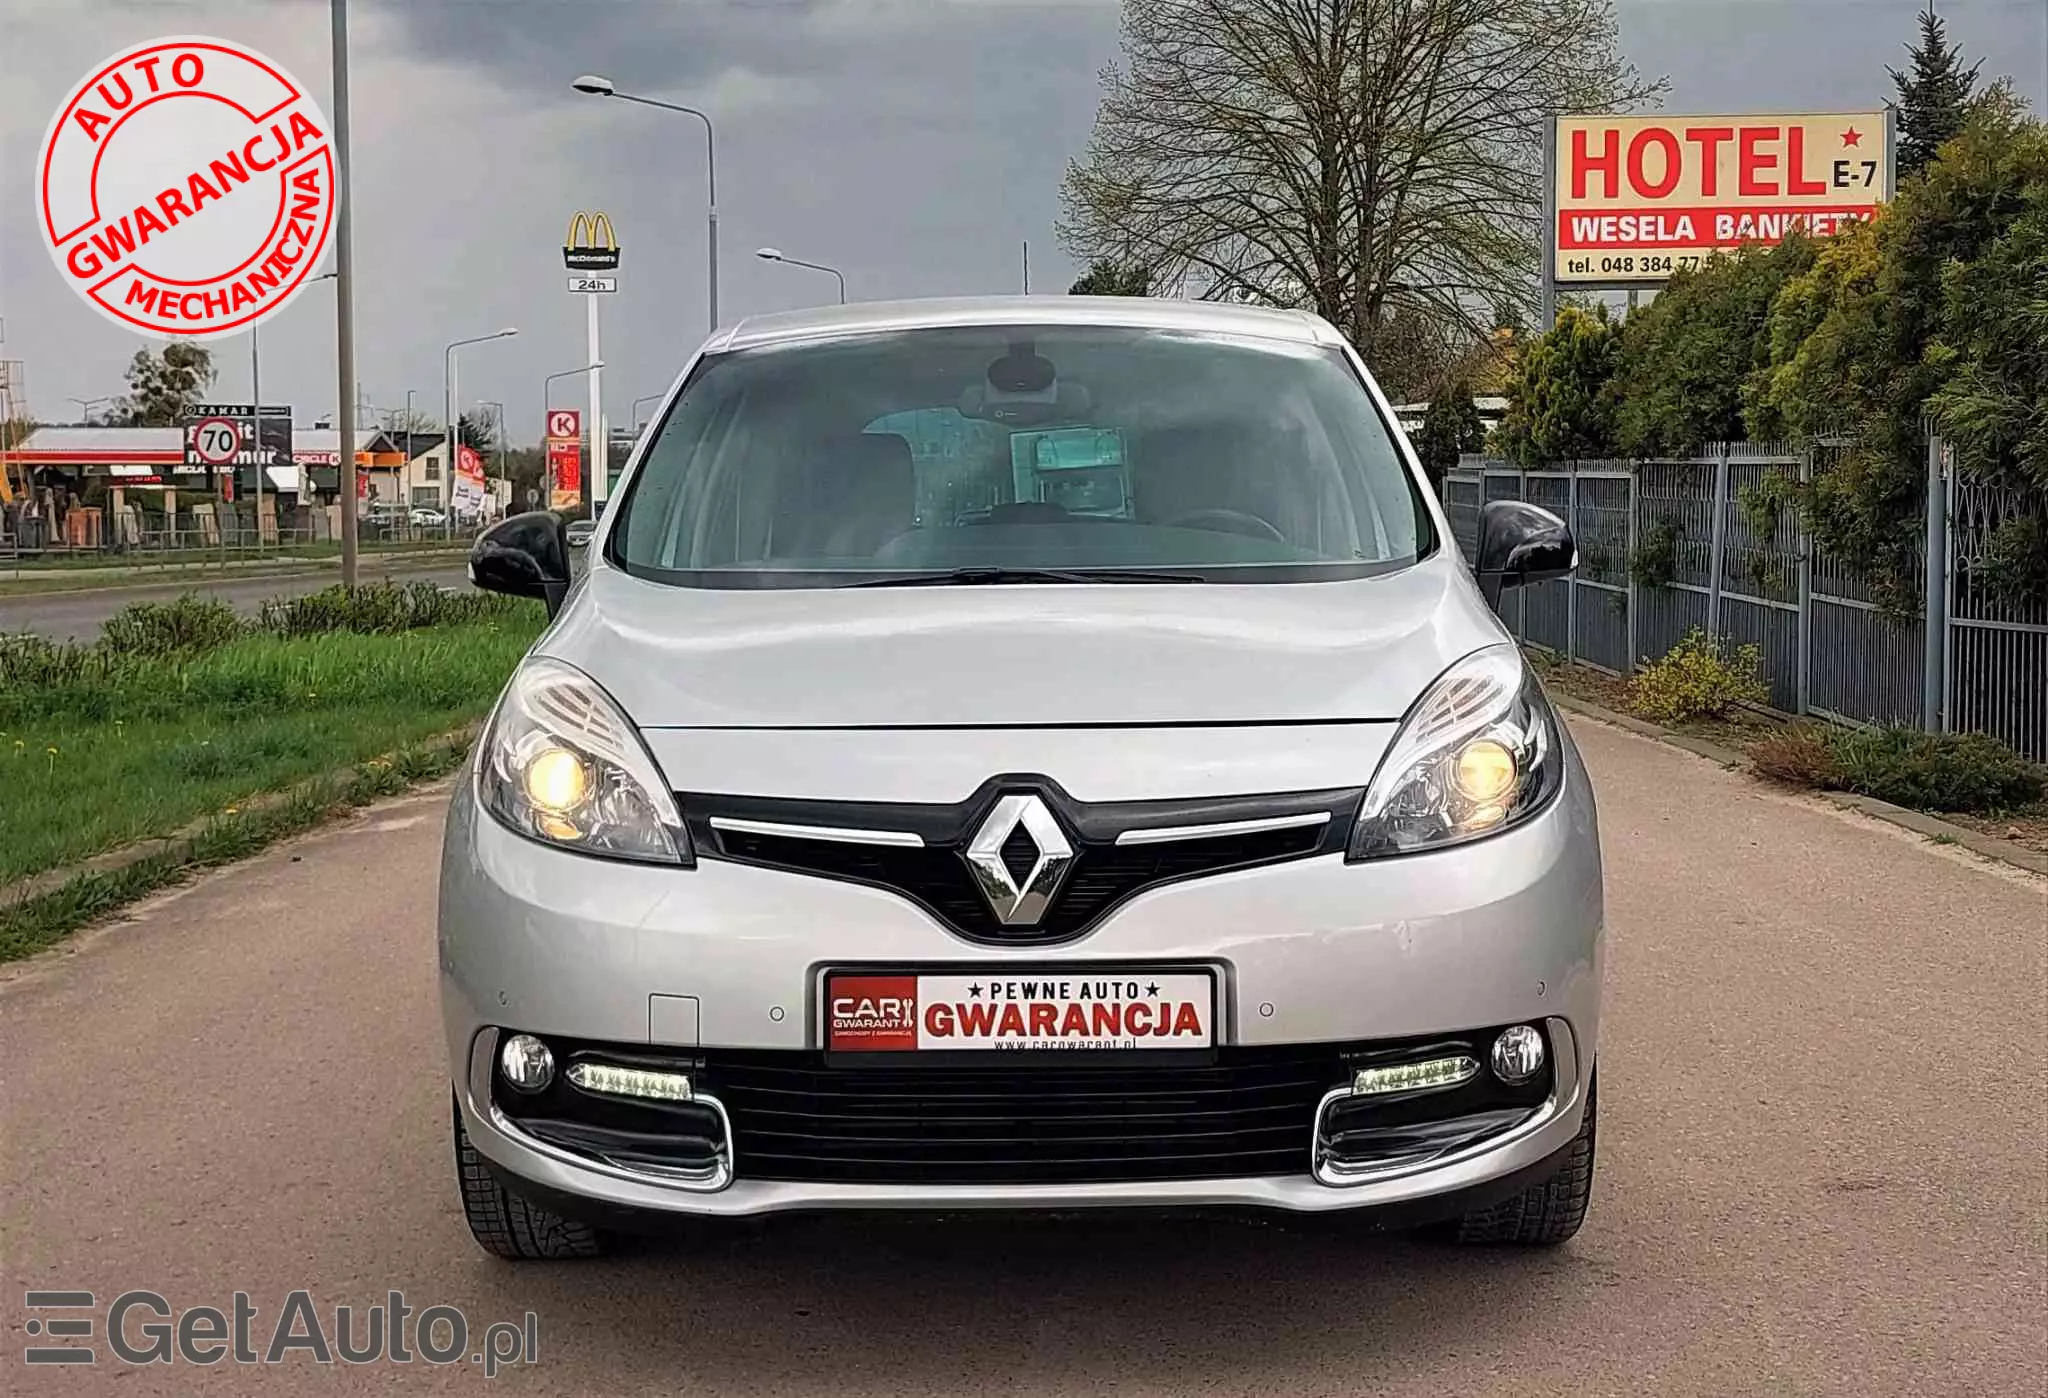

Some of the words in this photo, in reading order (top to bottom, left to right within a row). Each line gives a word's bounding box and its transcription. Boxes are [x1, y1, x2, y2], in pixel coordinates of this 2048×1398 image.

[1571, 126, 1827, 199] HOTEL
[1833, 160, 1877, 188] E-7
[1572, 214, 1696, 243] WESELA
[1567, 257, 1595, 273] tel.
[1601, 257, 1634, 273] 048
[1639, 256, 1673, 272] 384
[578, 280, 606, 290] 24h
[556, 416, 573, 433] K
[203, 429, 234, 453] 70
[991, 982, 1070, 999] PEWNE
[1080, 981, 1139, 998] AUTO
[833, 998, 901, 1018] CAR
[833, 1019, 901, 1028] GWARANT
[924, 1002, 1202, 1037] GWARANCJA
